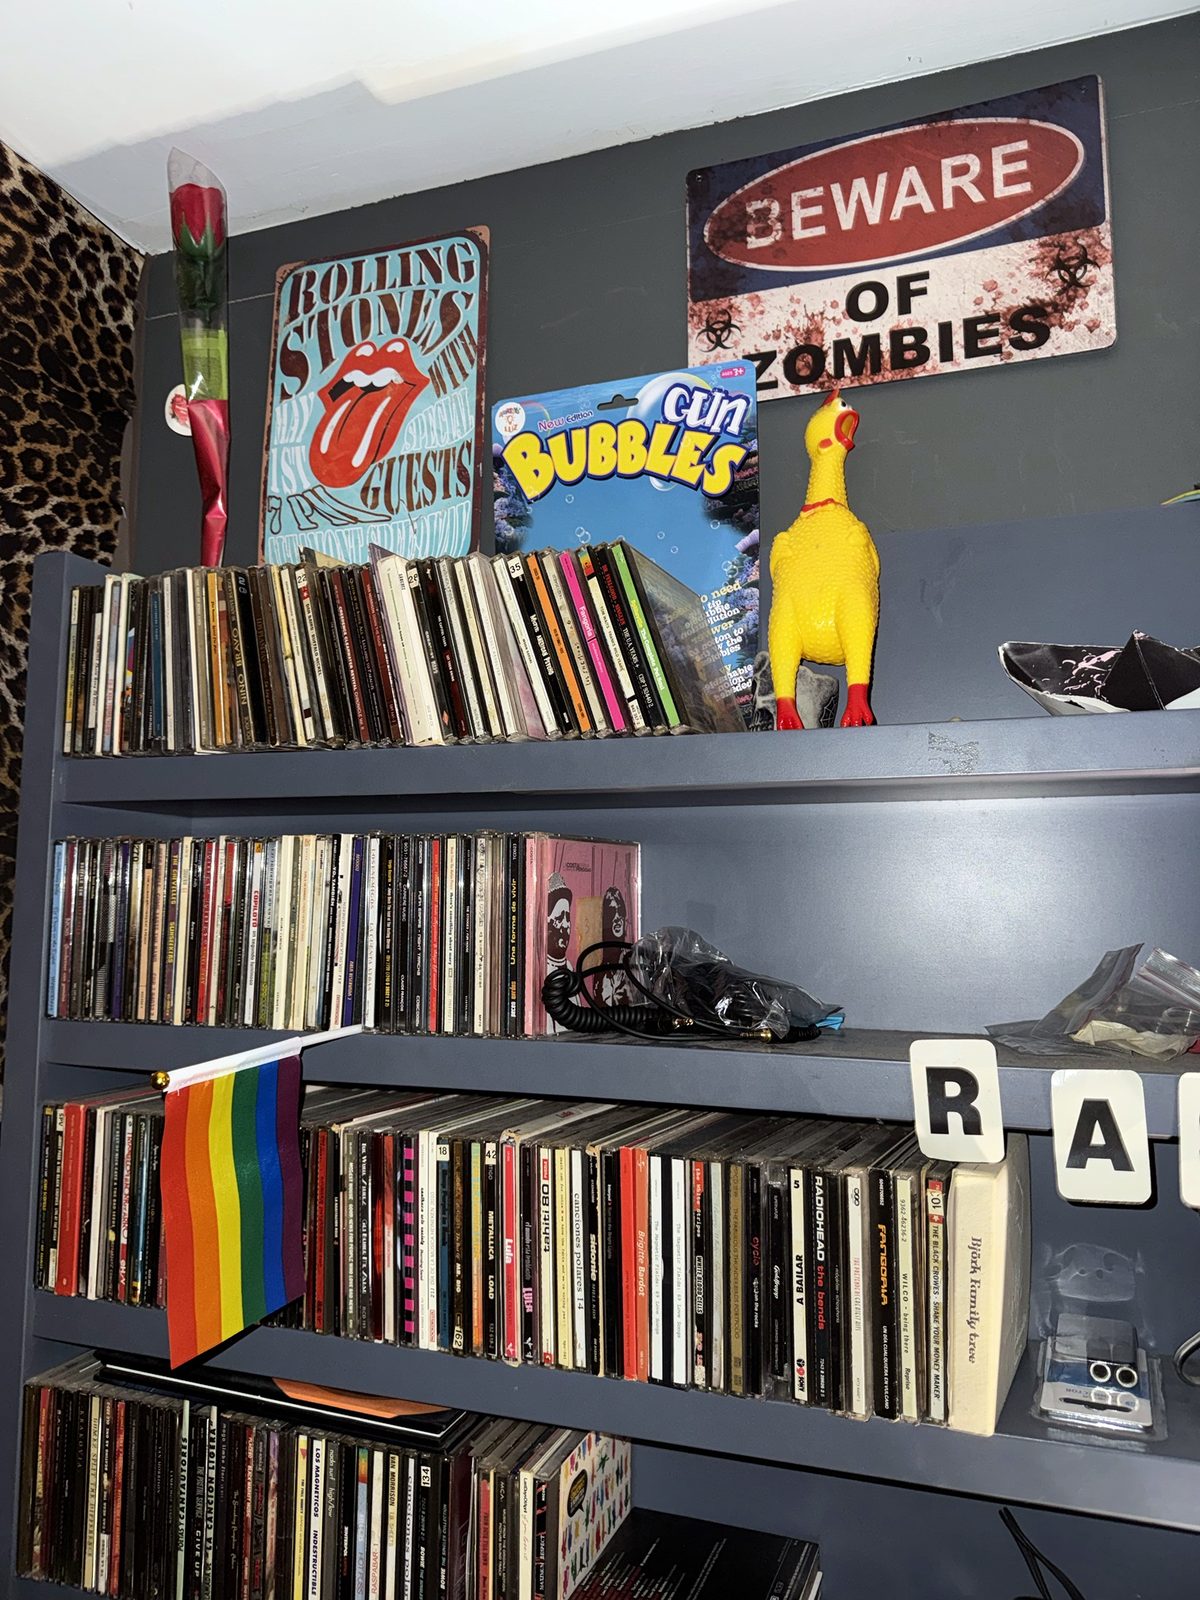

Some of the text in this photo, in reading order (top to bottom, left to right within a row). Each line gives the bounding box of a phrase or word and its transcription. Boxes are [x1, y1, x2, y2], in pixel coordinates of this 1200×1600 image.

[746, 139, 1032, 250] BEWARE
[286, 241, 477, 325] ROLLING
[845, 271, 930, 323] OF
[279, 288, 476, 401] STONES
[428, 320, 477, 398] WITH
[741, 307, 1052, 392] ZOMBIES
[360, 437, 473, 515] GUESTS
[509, 562, 522, 574] 35
[338, 606, 349, 636] CREEDENCE
[578, 605, 594, 637] Fangoria
[343, 636, 355, 669] CLEARWATER
[349, 669, 359, 691] REVIVAL
[251, 890, 260, 928] COPILOTO
[926, 1066, 984, 1136] R
[438, 1146, 448, 1156] 18
[486, 1151, 496, 1159] 42
[1065, 1097, 1136, 1172] A
[541, 1183, 551, 1253] tahiti 80
[732, 1221, 740, 1253] FABULOUS
[504, 1238, 514, 1264] Lula
[573, 1192, 585, 1310] canciones polares 14
[590, 1233, 598, 1281] sidonie
[637, 1230, 646, 1297] Brigitte Bardot
[695, 1255, 703, 1276] WHITE
[814, 1175, 826, 1330] RADIOHEAD the bends
[877, 1223, 889, 1306] FANGORIA
[772, 1264, 781, 1299] Goldfrapp
[795, 1254, 804, 1306] A BAILAR
[966, 1236, 983, 1364] Björk Family tree
[454, 1328, 463, 1348] 162
[901, 1273, 911, 1354] WILCO being there
[932, 1225, 941, 1399] THE BLACK CROWES SHAKE YOUR MONEY MAKER
[904, 1367, 912, 1391] Reprise
[179, 1437, 188, 1521] CANTAUTORES
[328, 1467, 336, 1481] surf
[422, 1468, 430, 1486] 134
[327, 1487, 336, 1518] high/low
[311, 1530, 319, 1596] INDESTRUCTIBLE
